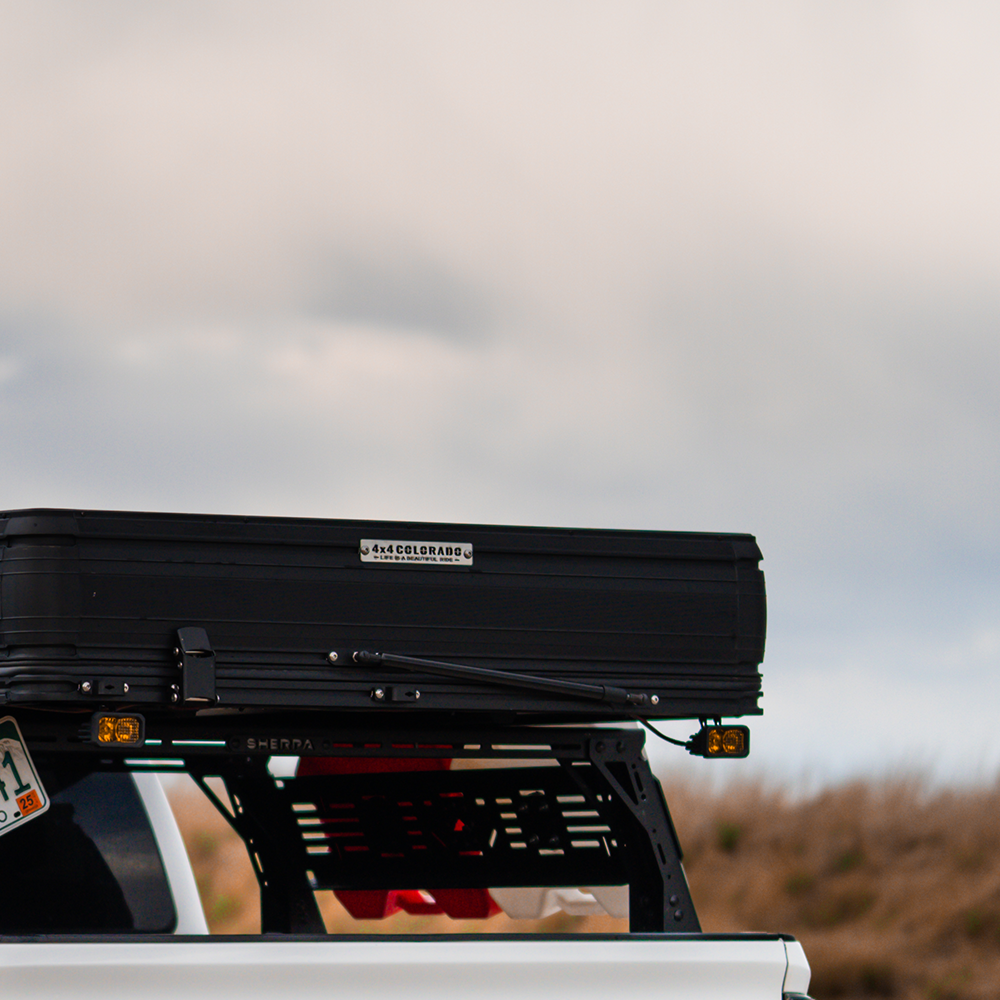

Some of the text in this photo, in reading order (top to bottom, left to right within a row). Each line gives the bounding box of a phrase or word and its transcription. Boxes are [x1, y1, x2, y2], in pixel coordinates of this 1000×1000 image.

[371, 544, 462, 556] 4x4 COLORADO
[247, 738, 315, 750] SHERPA
[19, 794, 34, 810] 25
